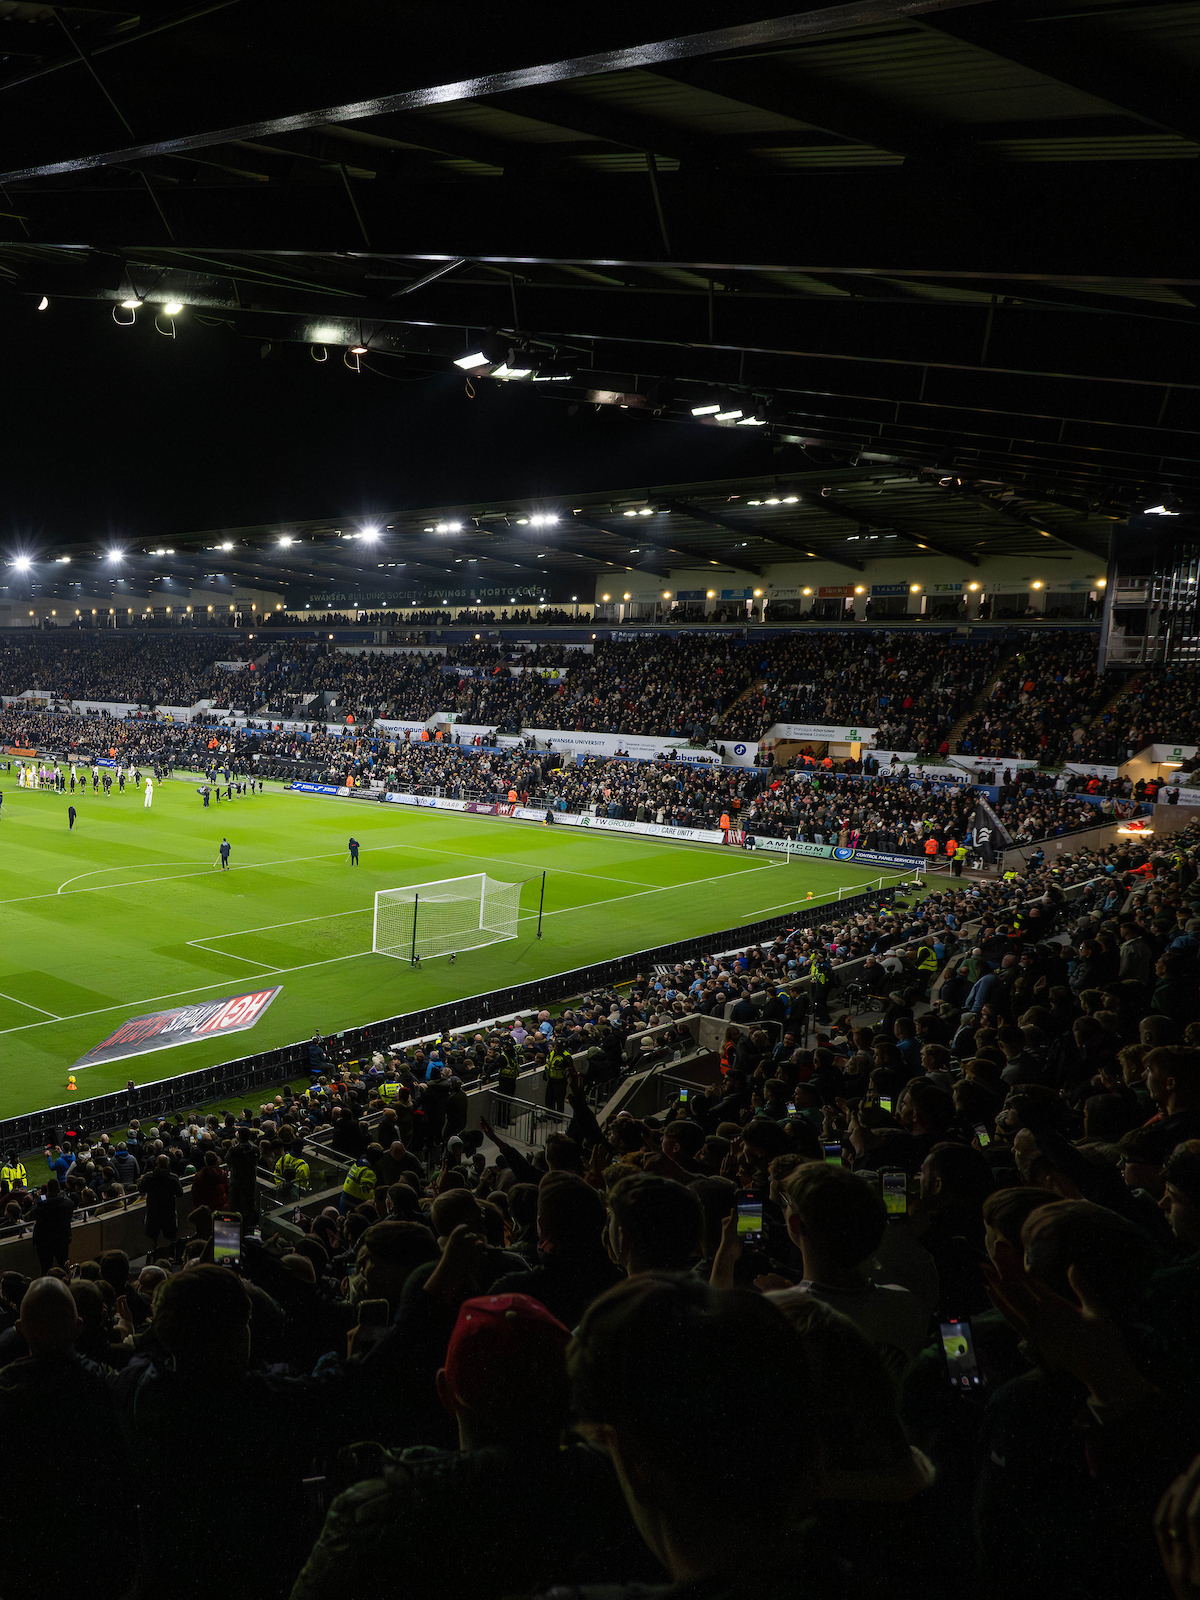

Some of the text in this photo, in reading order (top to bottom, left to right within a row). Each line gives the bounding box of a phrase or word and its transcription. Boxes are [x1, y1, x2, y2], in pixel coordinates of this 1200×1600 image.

[310, 594, 346, 602] SWANSEA
[348, 592, 386, 601] BUILDING
[387, 590, 423, 600] SOCIETY
[428, 589, 467, 598] SAVINGS
[608, 819, 636, 828] GROUP
[661, 827, 678, 836] CARE
[855, 851, 879, 861] CONTROL
[893, 857, 917, 865] SERVICES
